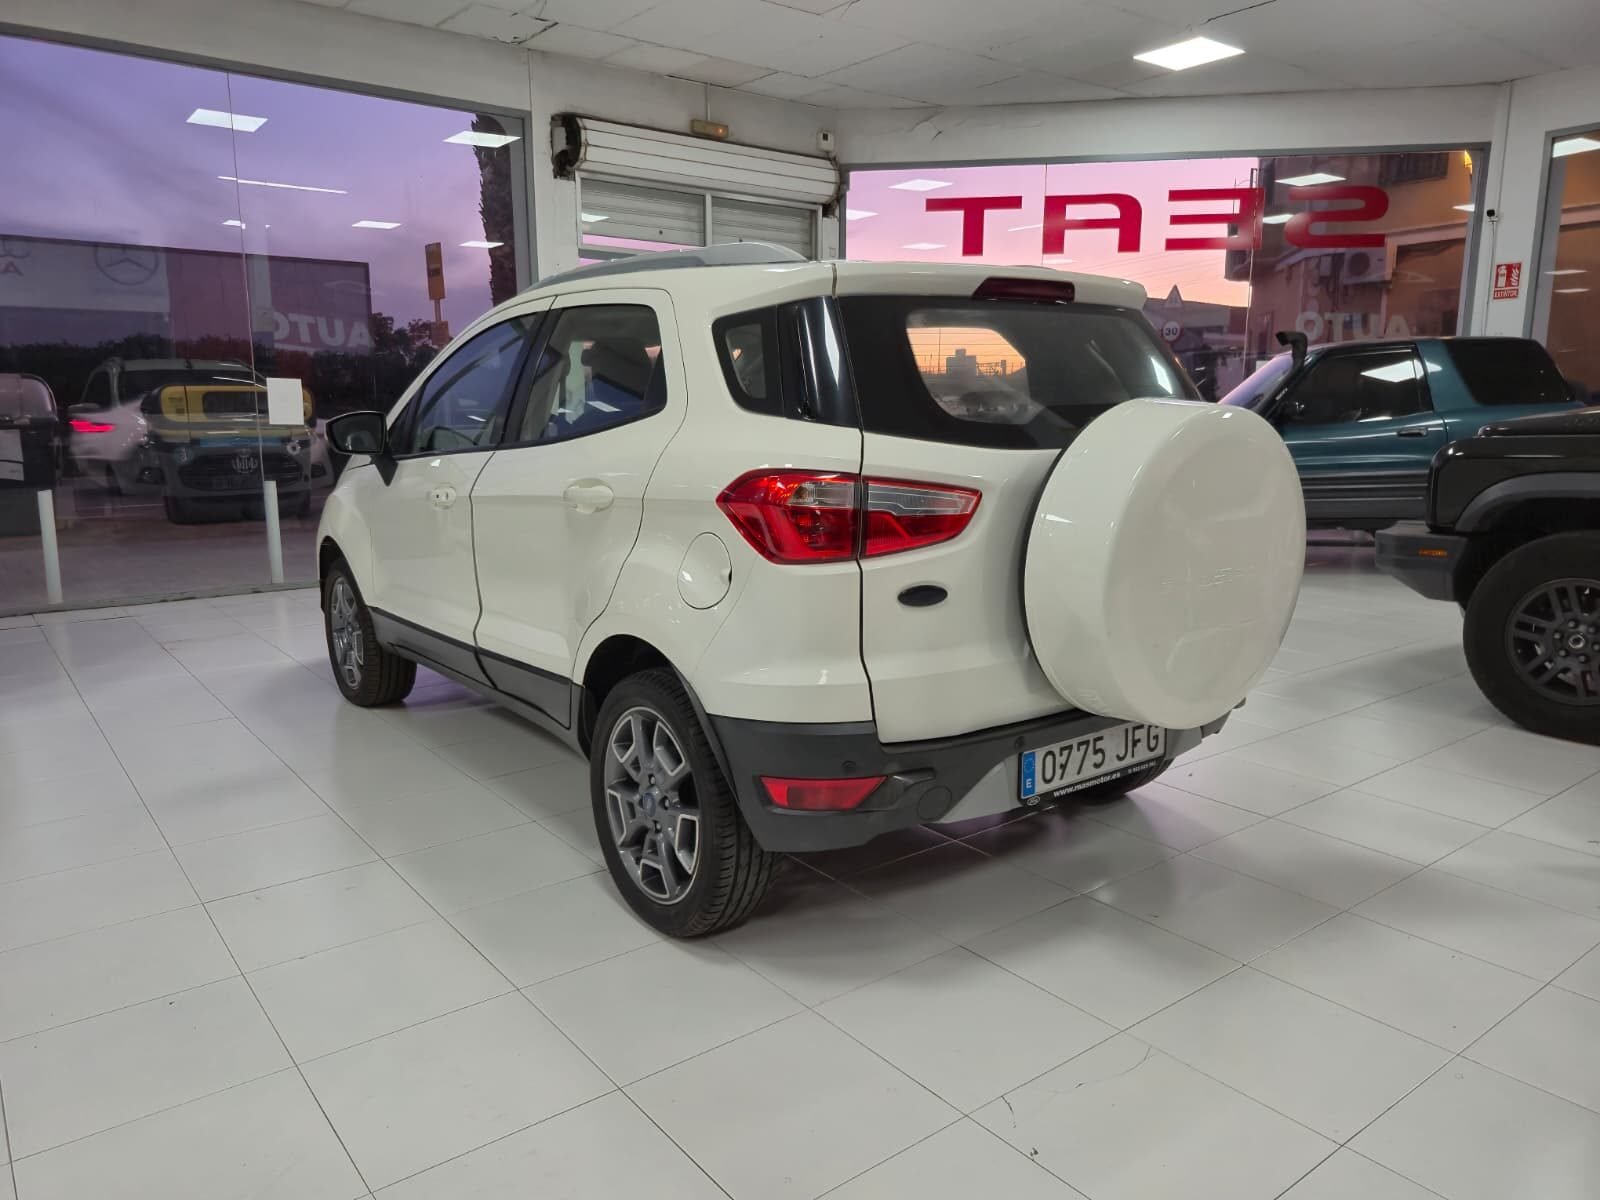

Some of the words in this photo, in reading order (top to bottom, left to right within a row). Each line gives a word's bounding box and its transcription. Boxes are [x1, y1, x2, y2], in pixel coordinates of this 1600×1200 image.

[1165, 327, 1178, 337] 30
[1042, 735, 1106, 785] 0775
[1115, 724, 1159, 762] JFG
[1025, 778, 1032, 789] E
